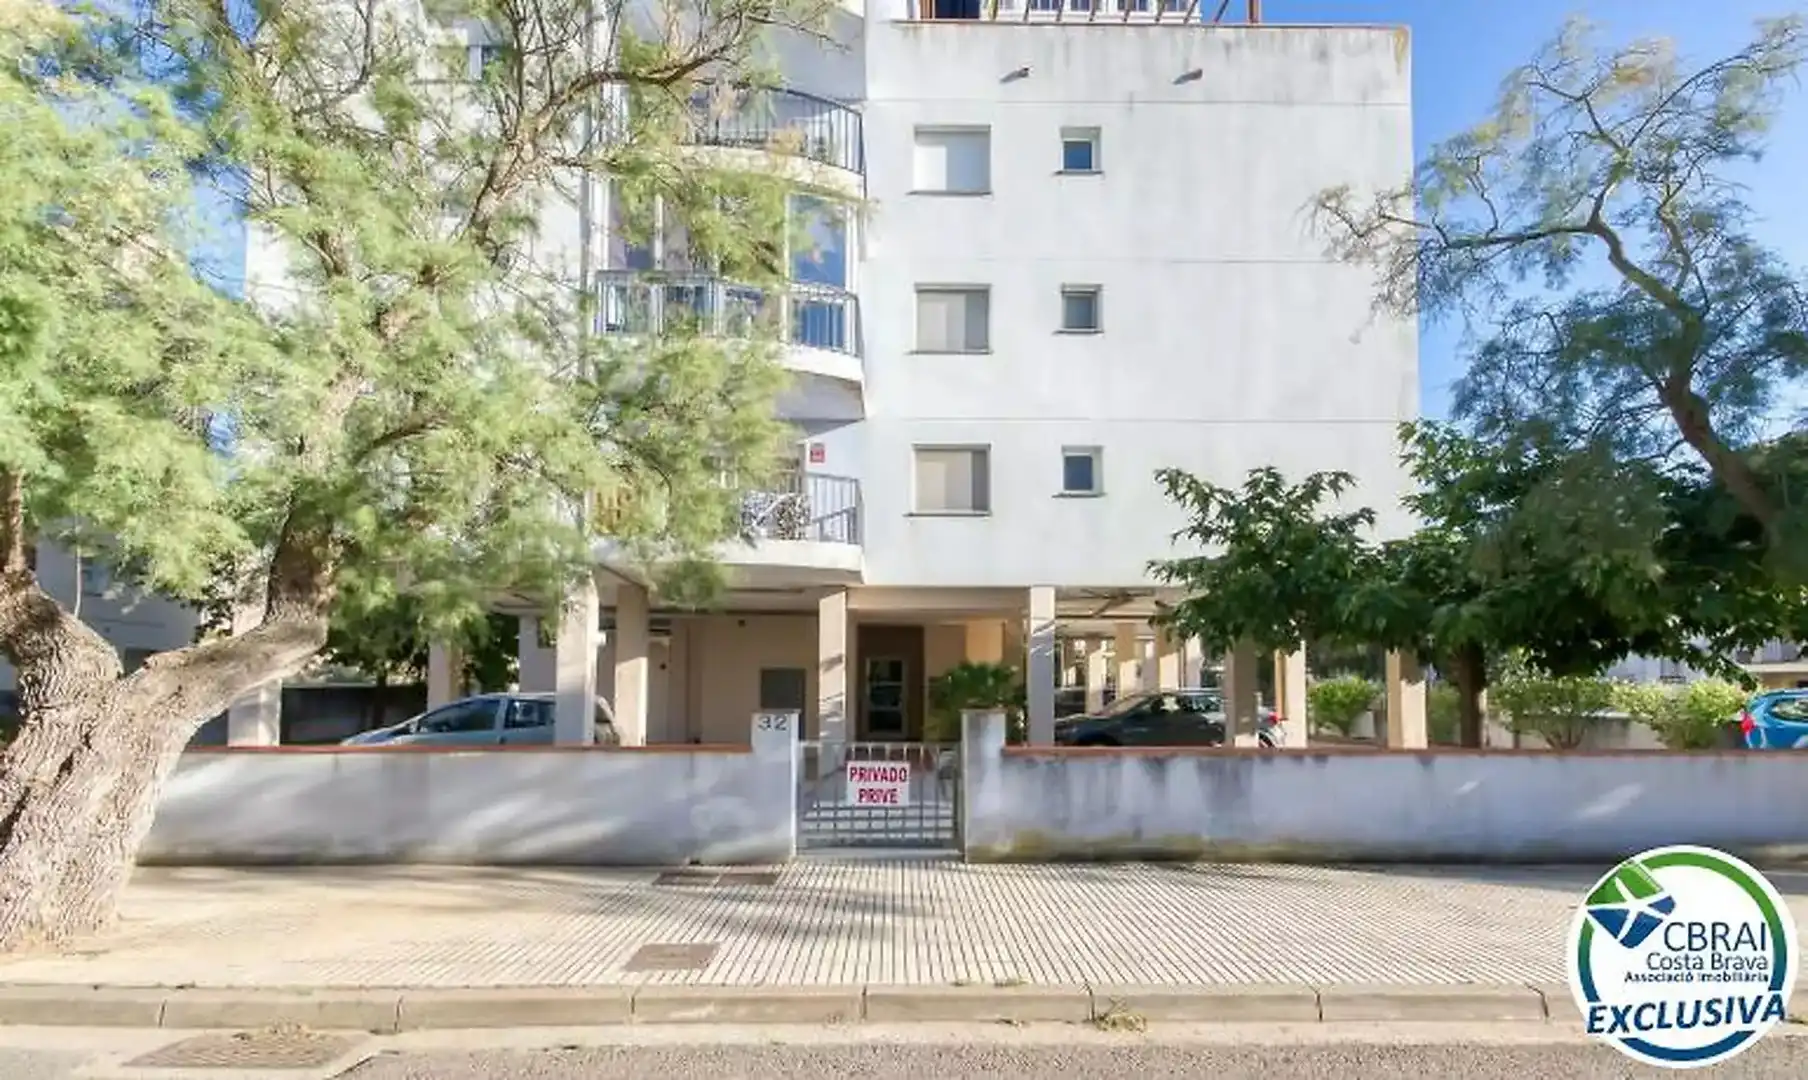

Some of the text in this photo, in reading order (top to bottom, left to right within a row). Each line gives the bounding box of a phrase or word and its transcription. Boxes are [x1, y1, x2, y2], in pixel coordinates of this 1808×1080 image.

[758, 716, 787, 731] 32
[850, 767, 907, 782] PRIVADO
[859, 788, 898, 803] PRIVE
